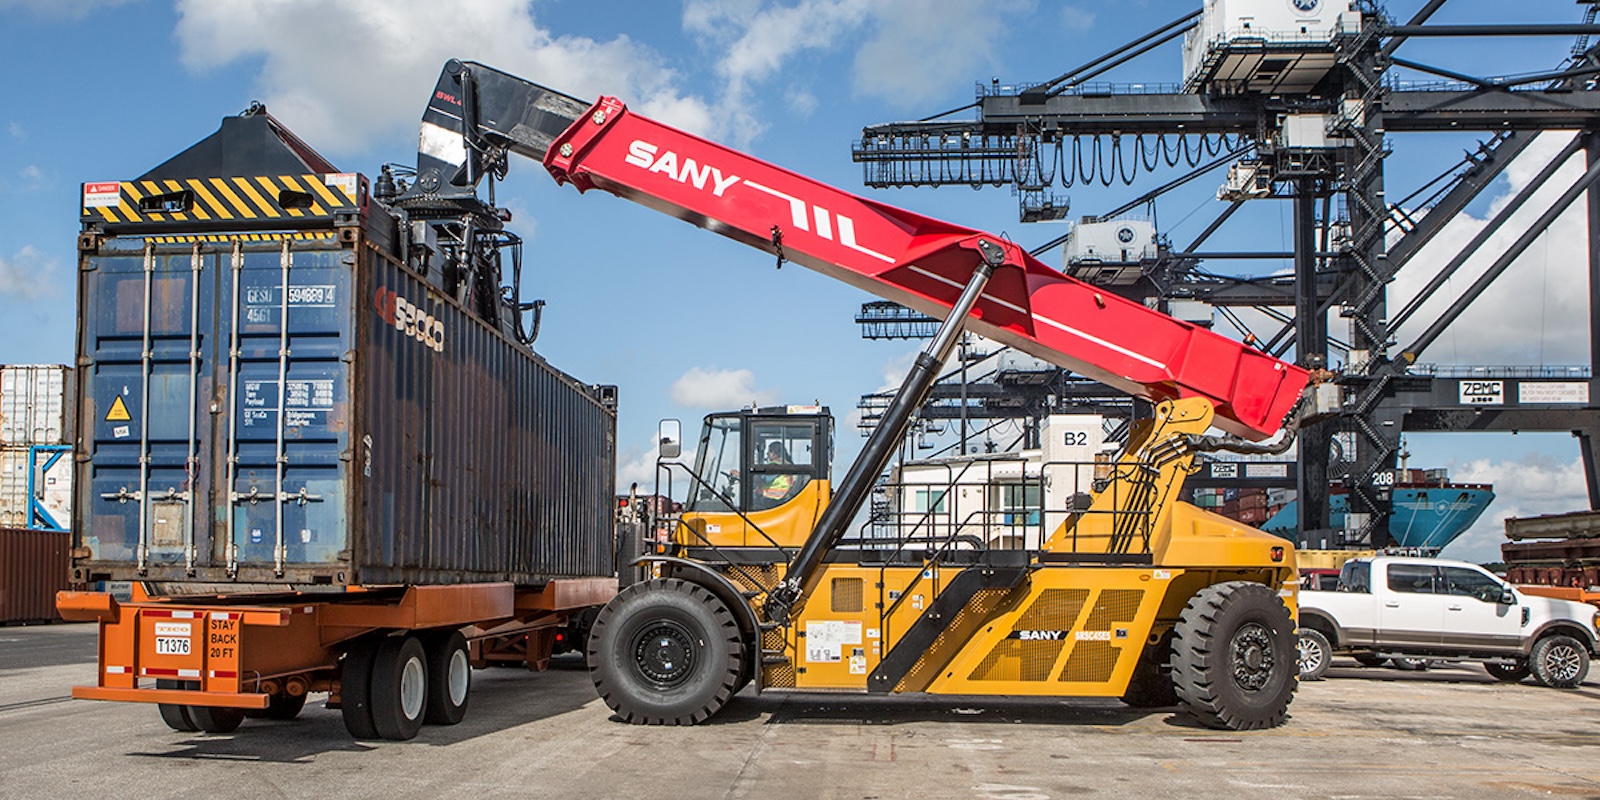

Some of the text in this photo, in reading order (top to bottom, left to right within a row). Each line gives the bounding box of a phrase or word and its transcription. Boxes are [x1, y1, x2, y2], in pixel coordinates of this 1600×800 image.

[624, 139, 741, 197] SANY
[1462, 382, 1501, 397] ZPMC
[1064, 431, 1088, 446] B2
[1372, 471, 1394, 485] 208
[211, 620, 235, 630] STAY
[211, 633, 237, 644] BACK
[1020, 629, 1061, 640] SANY
[158, 638, 189, 653] T1376
[210, 647, 234, 658] 20 FT
